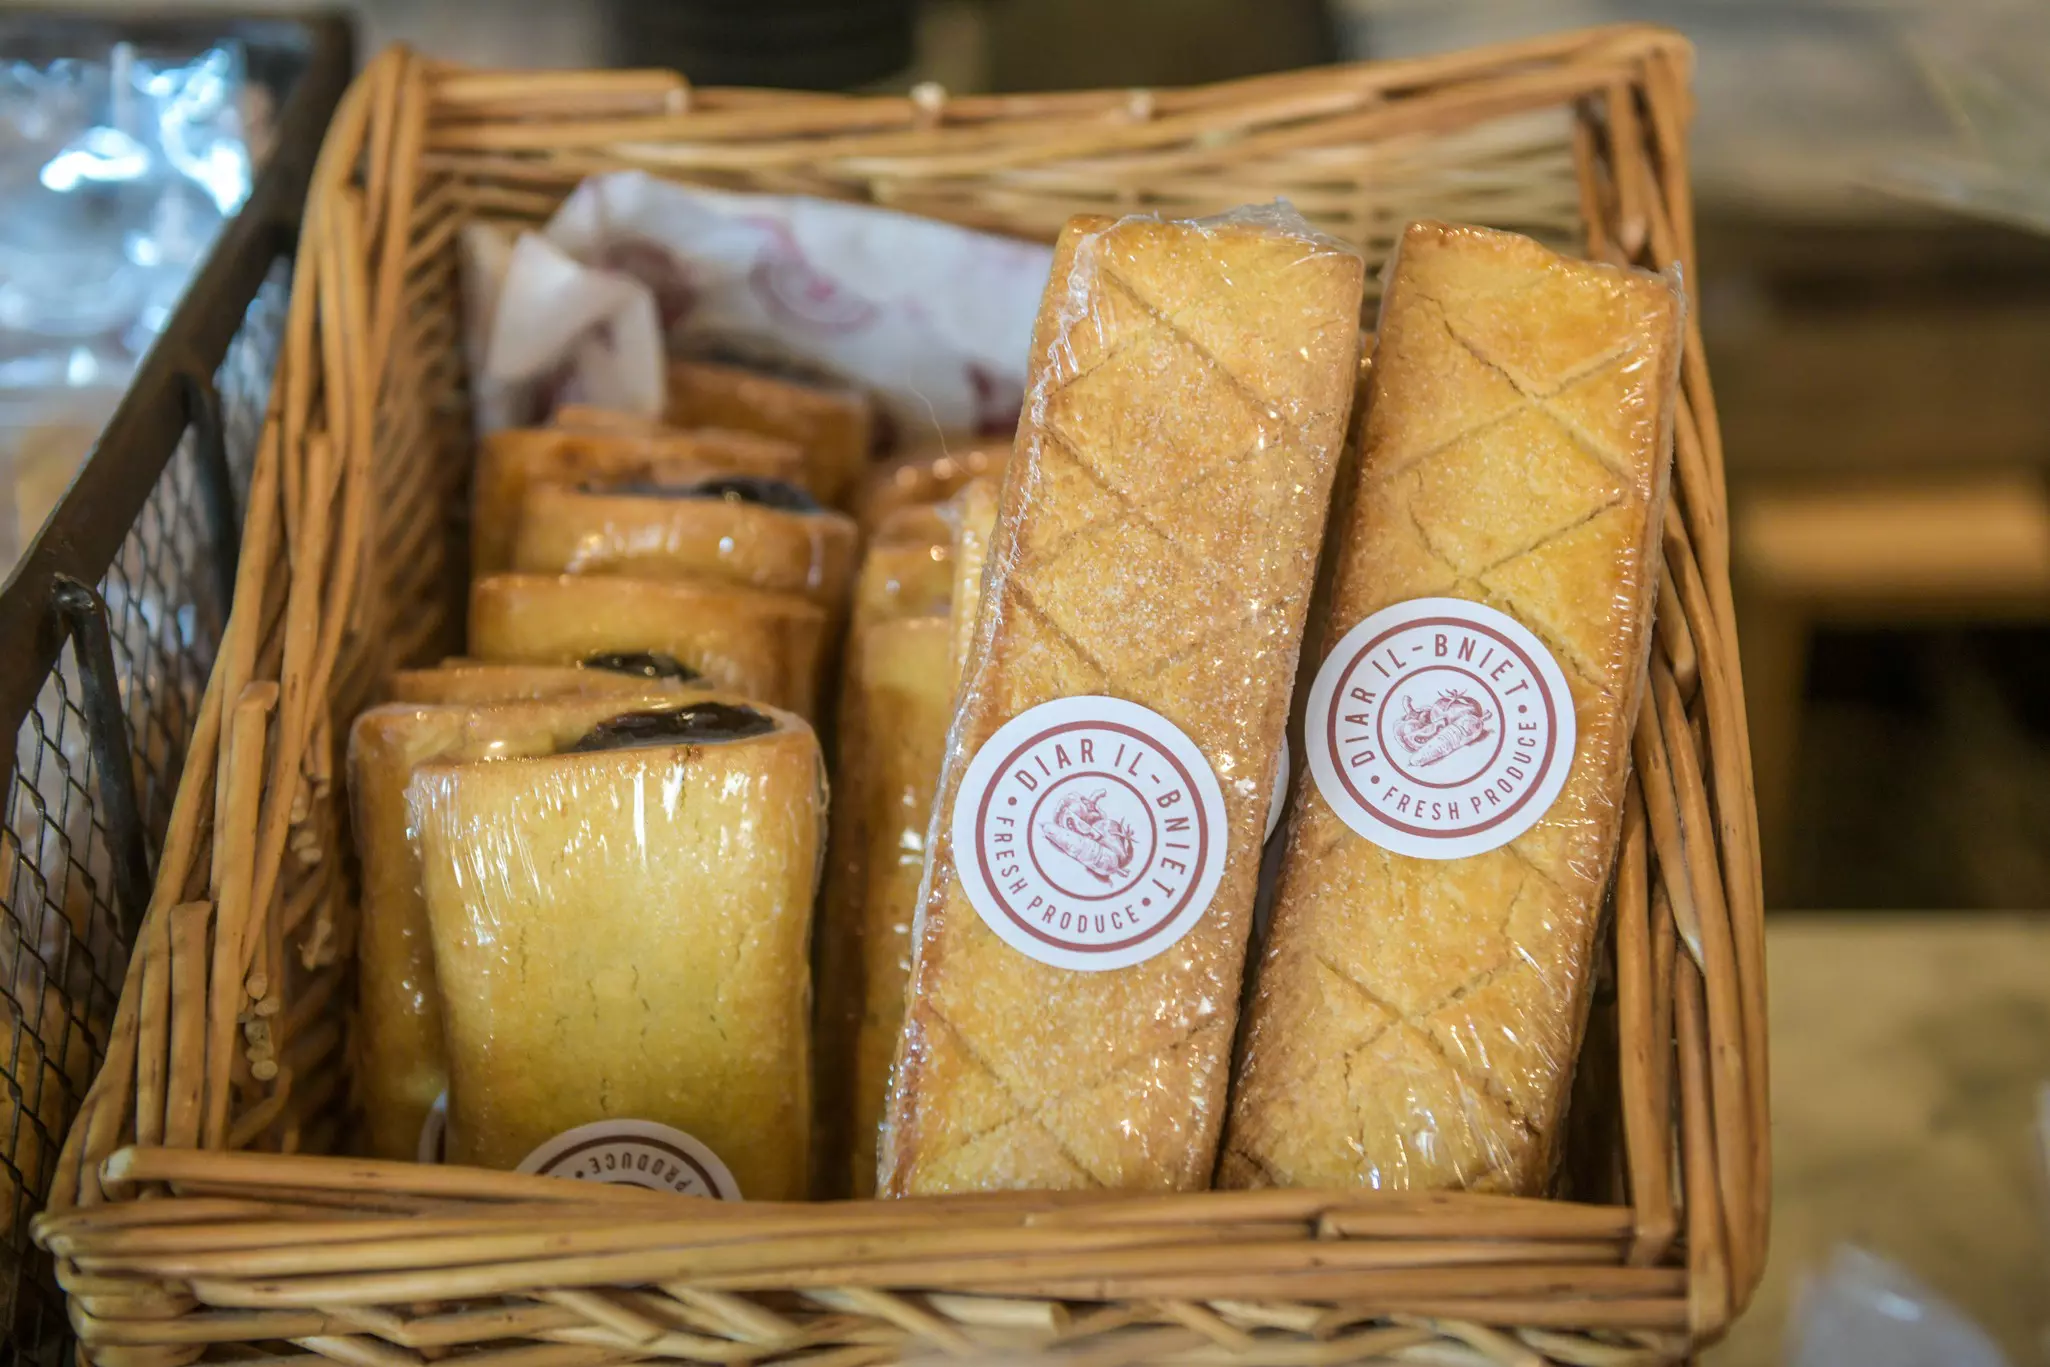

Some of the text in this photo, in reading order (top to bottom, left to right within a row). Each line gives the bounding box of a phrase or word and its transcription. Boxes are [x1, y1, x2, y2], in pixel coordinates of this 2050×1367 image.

[1344, 633, 1530, 769] DIAR IL-BNIET
[1014, 738, 1191, 899] DIAR IL-BNIET
[1382, 721, 1537, 821] FRESH PRODUCE
[993, 815, 1140, 934] FRESH PRODUCE
[589, 1152, 692, 1192] PRODUCE
